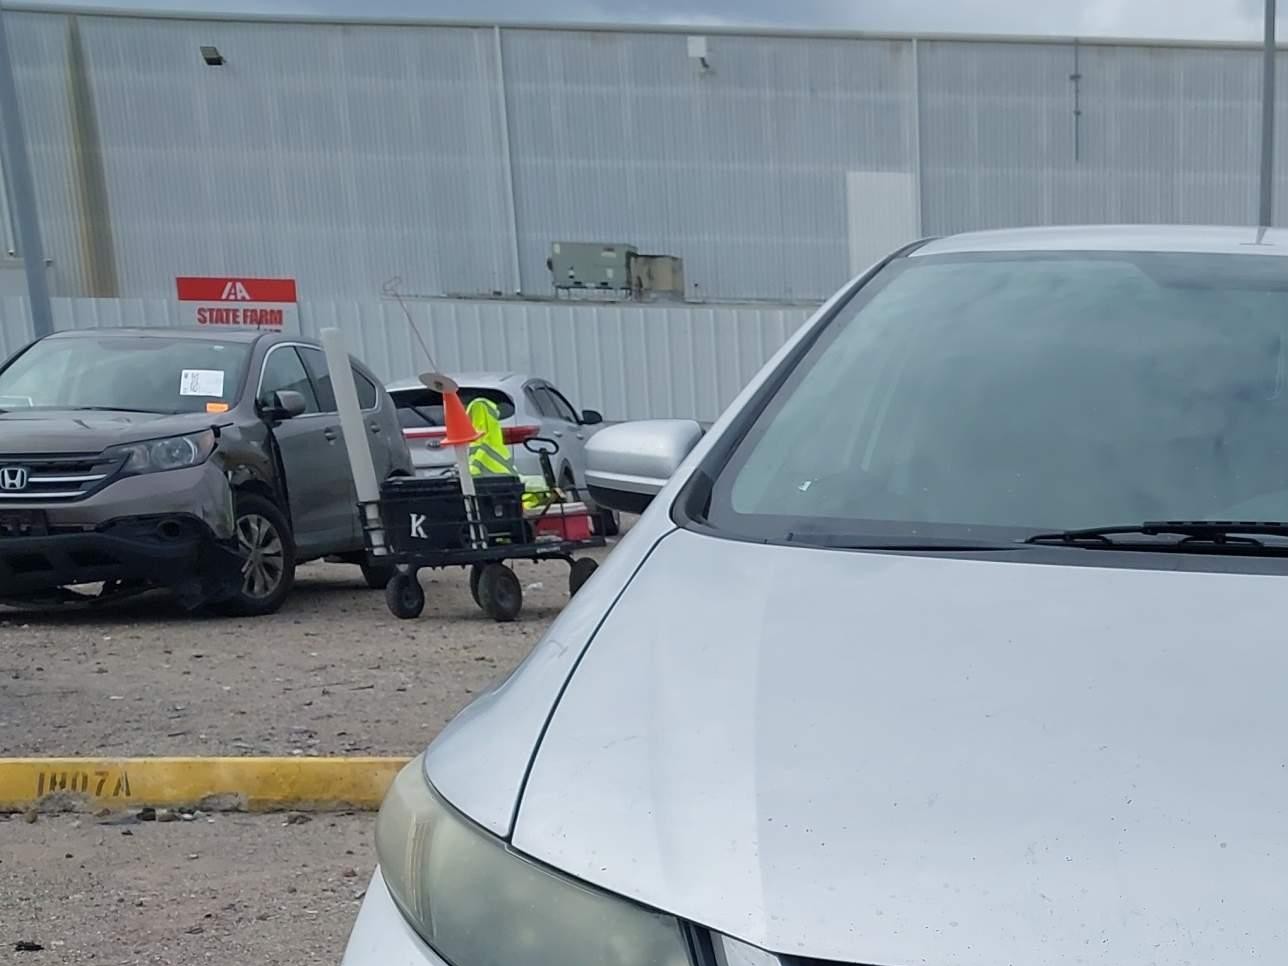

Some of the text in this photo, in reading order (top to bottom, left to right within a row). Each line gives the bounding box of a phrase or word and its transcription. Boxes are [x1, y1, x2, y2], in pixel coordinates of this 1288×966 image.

[197, 307, 283, 326] STATE FARM
[409, 513, 428, 538] K
